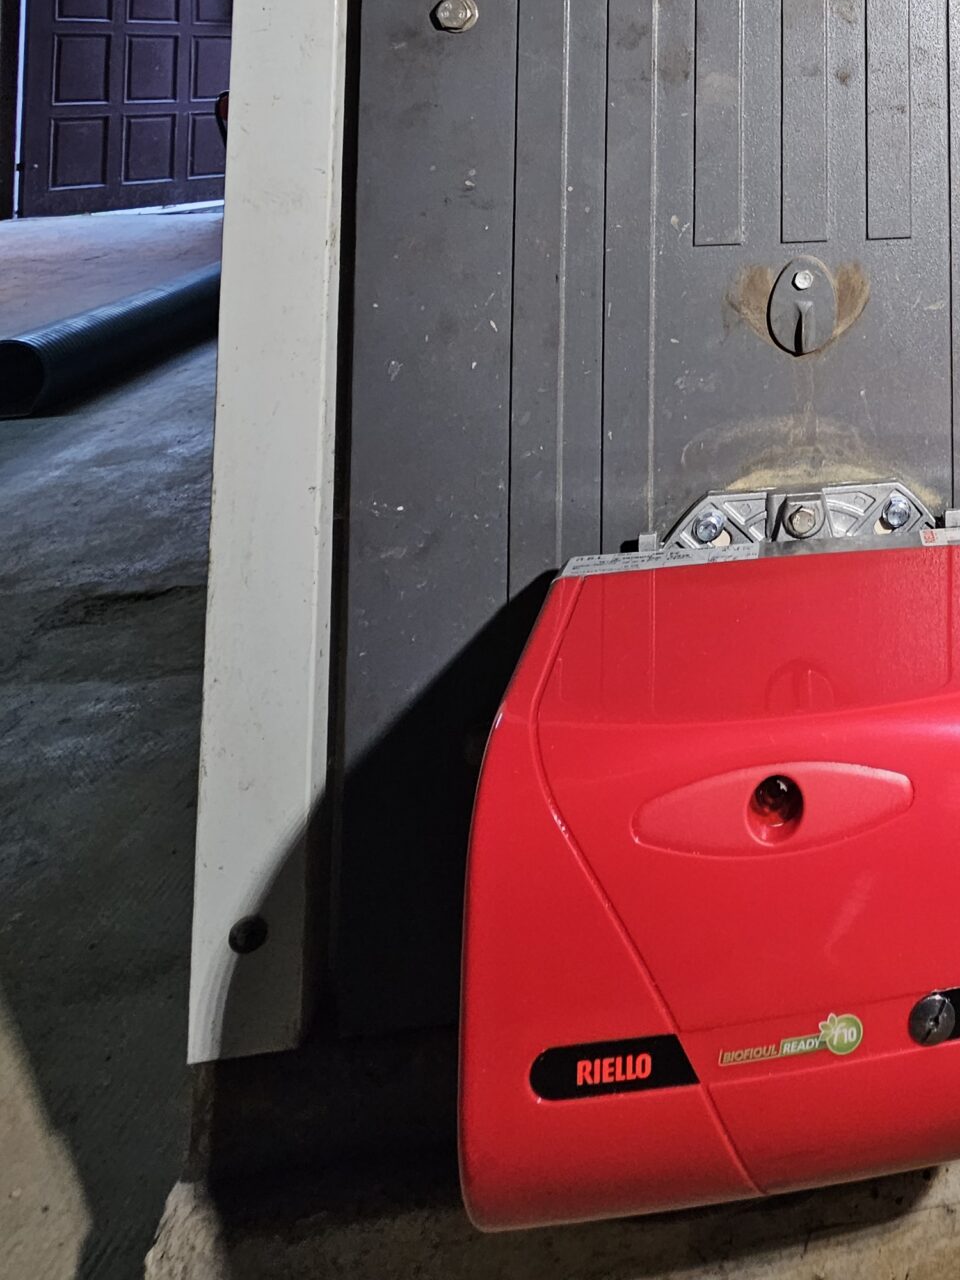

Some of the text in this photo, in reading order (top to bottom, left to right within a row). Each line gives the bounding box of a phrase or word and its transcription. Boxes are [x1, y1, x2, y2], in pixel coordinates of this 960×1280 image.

[722, 1044, 777, 1063] BIOFIOUL
[782, 1037, 821, 1055] READY
[576, 1052, 652, 1086] RIELLO
